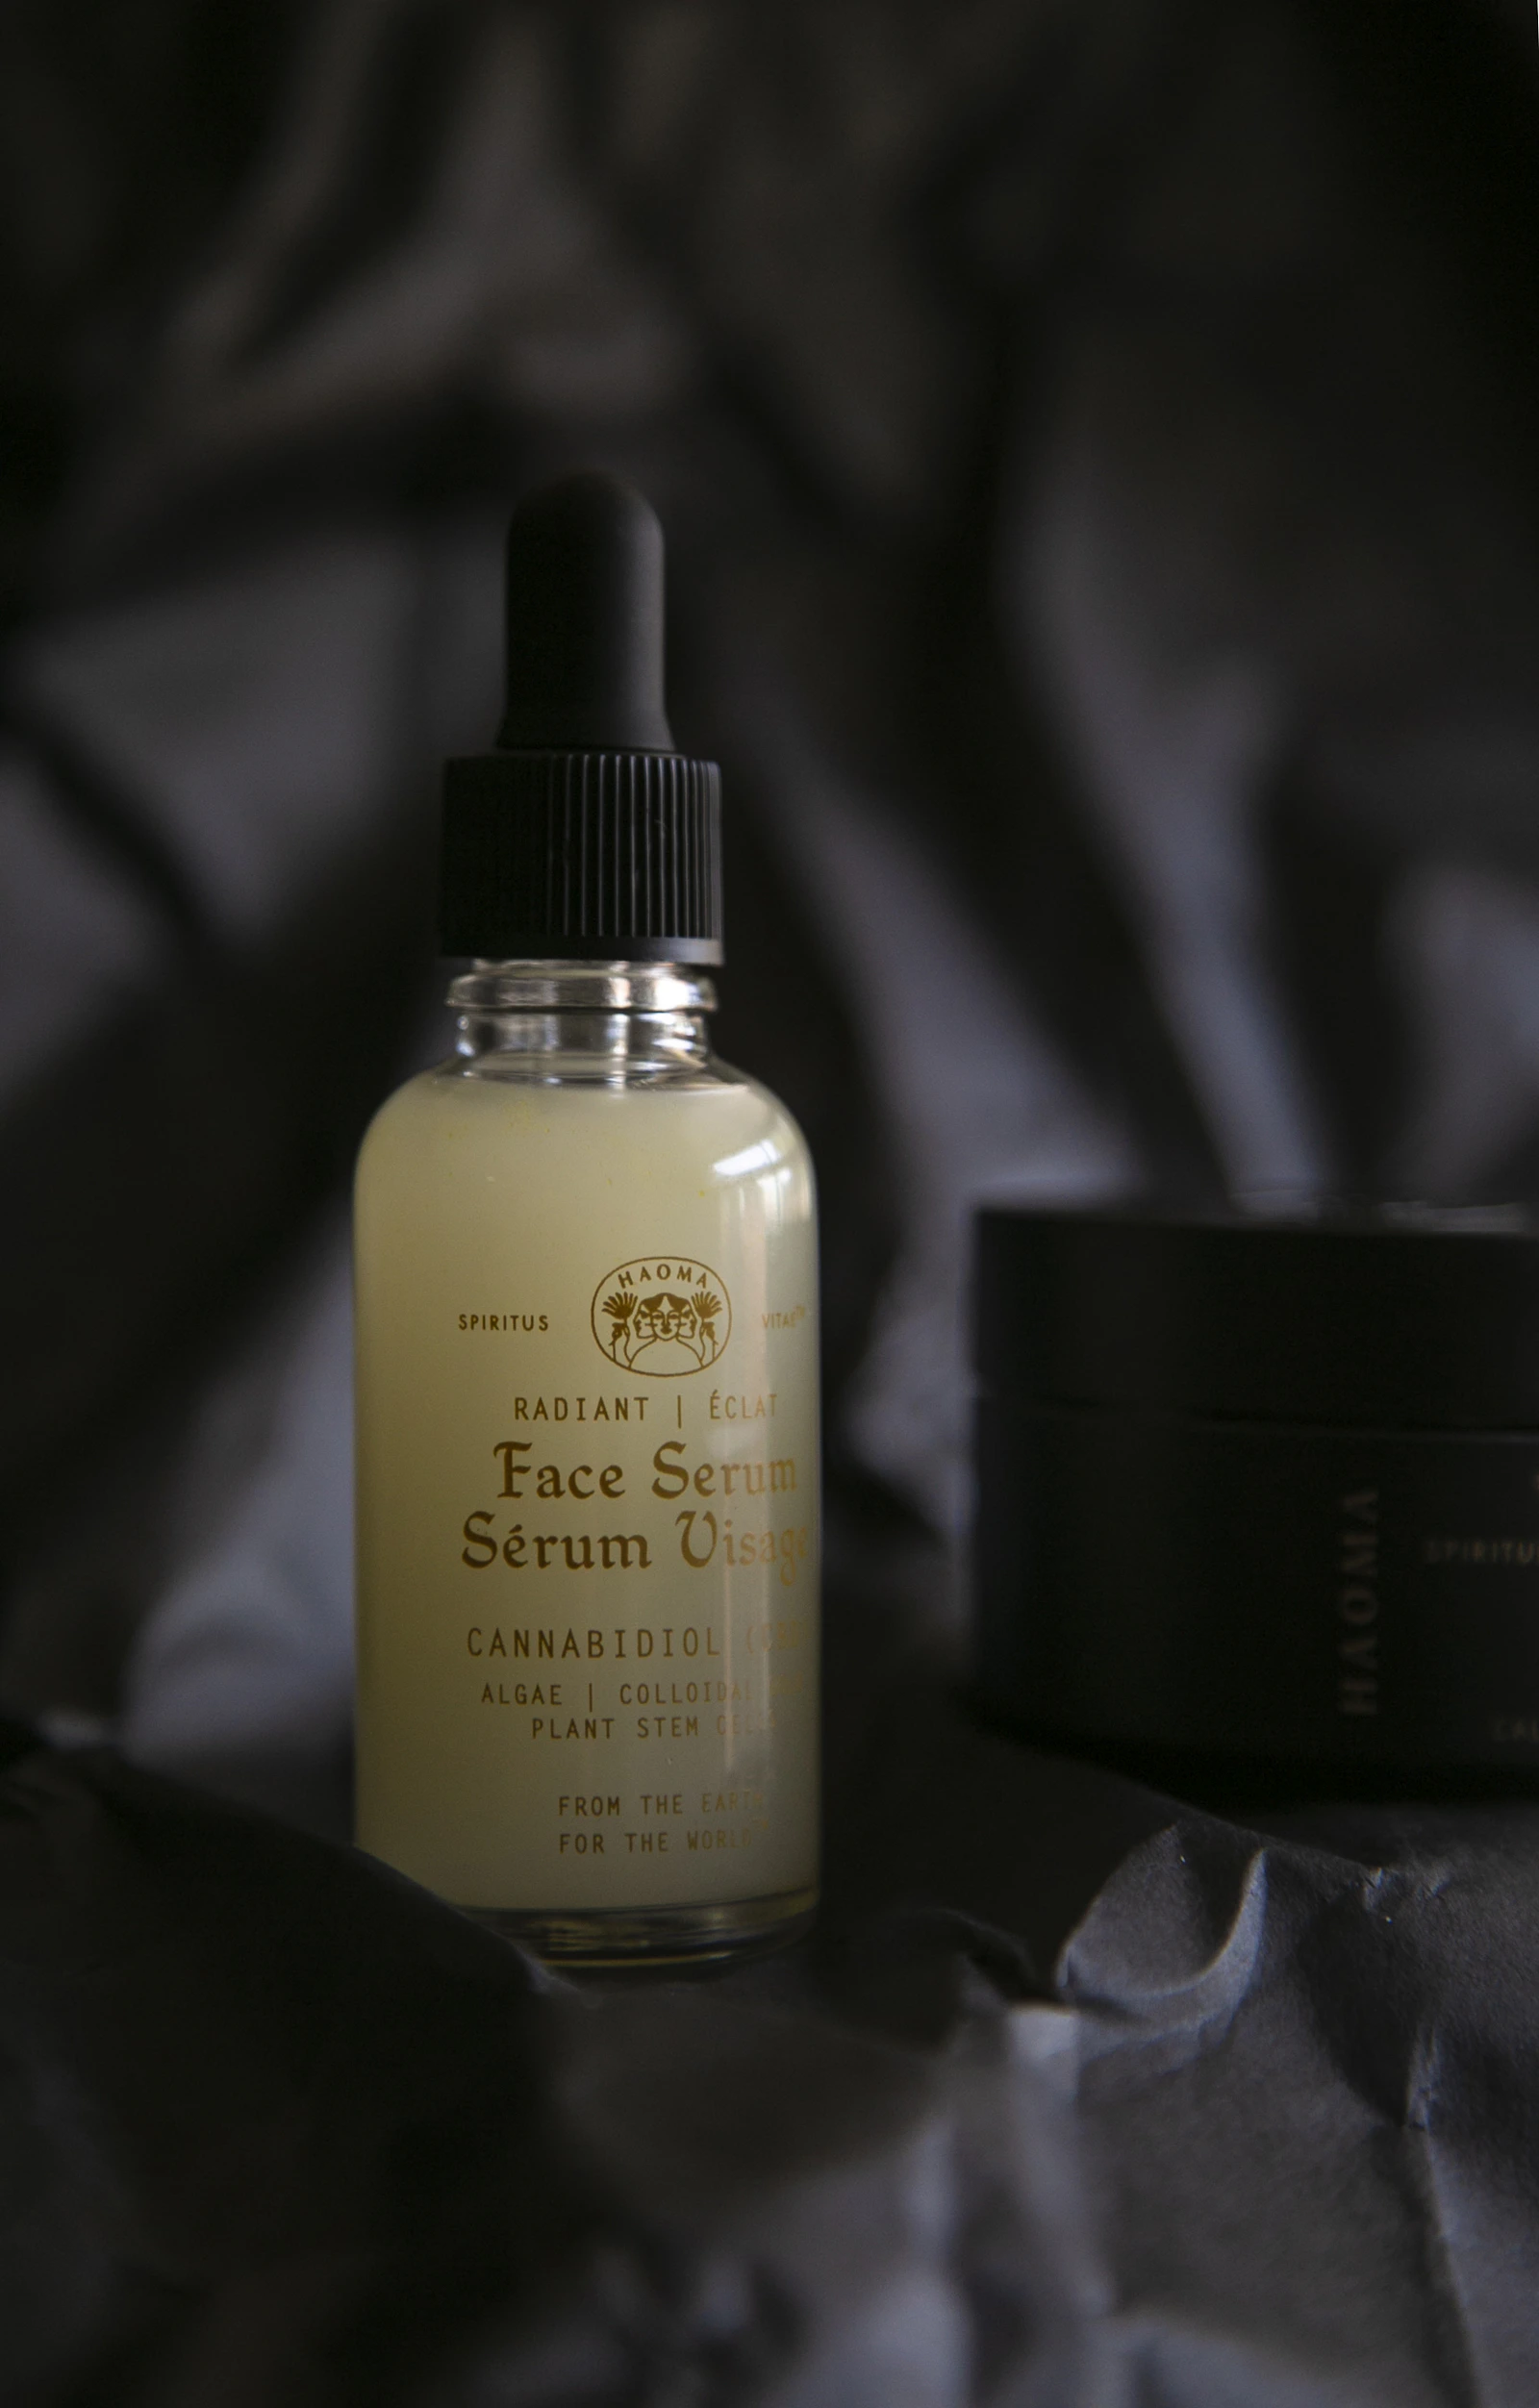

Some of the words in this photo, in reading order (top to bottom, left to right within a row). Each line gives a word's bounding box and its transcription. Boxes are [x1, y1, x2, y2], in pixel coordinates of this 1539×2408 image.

[618, 1264, 707, 1289] HAOMA
[459, 1314, 549, 1332] SPIRITUS
[514, 1396, 649, 1421] RADIANT
[709, 1390, 777, 1419] ÉCLAT
[492, 1441, 625, 1499] Face
[651, 1441, 796, 1499] Serum
[462, 1511, 652, 1569] Sérum
[1424, 1539, 1539, 1566] SPIRITU
[1341, 1491, 1379, 1716] HAOMA
[467, 1627, 720, 1659] CANNABIDIOL
[481, 1683, 563, 1706] ALGAE
[532, 1718, 615, 1740] PLANT
[637, 1717, 698, 1739] STEM
[559, 1796, 620, 1817] FROM
[641, 1794, 683, 1816] THE
[559, 1834, 606, 1855] FOR
[624, 1833, 669, 1853] THE
